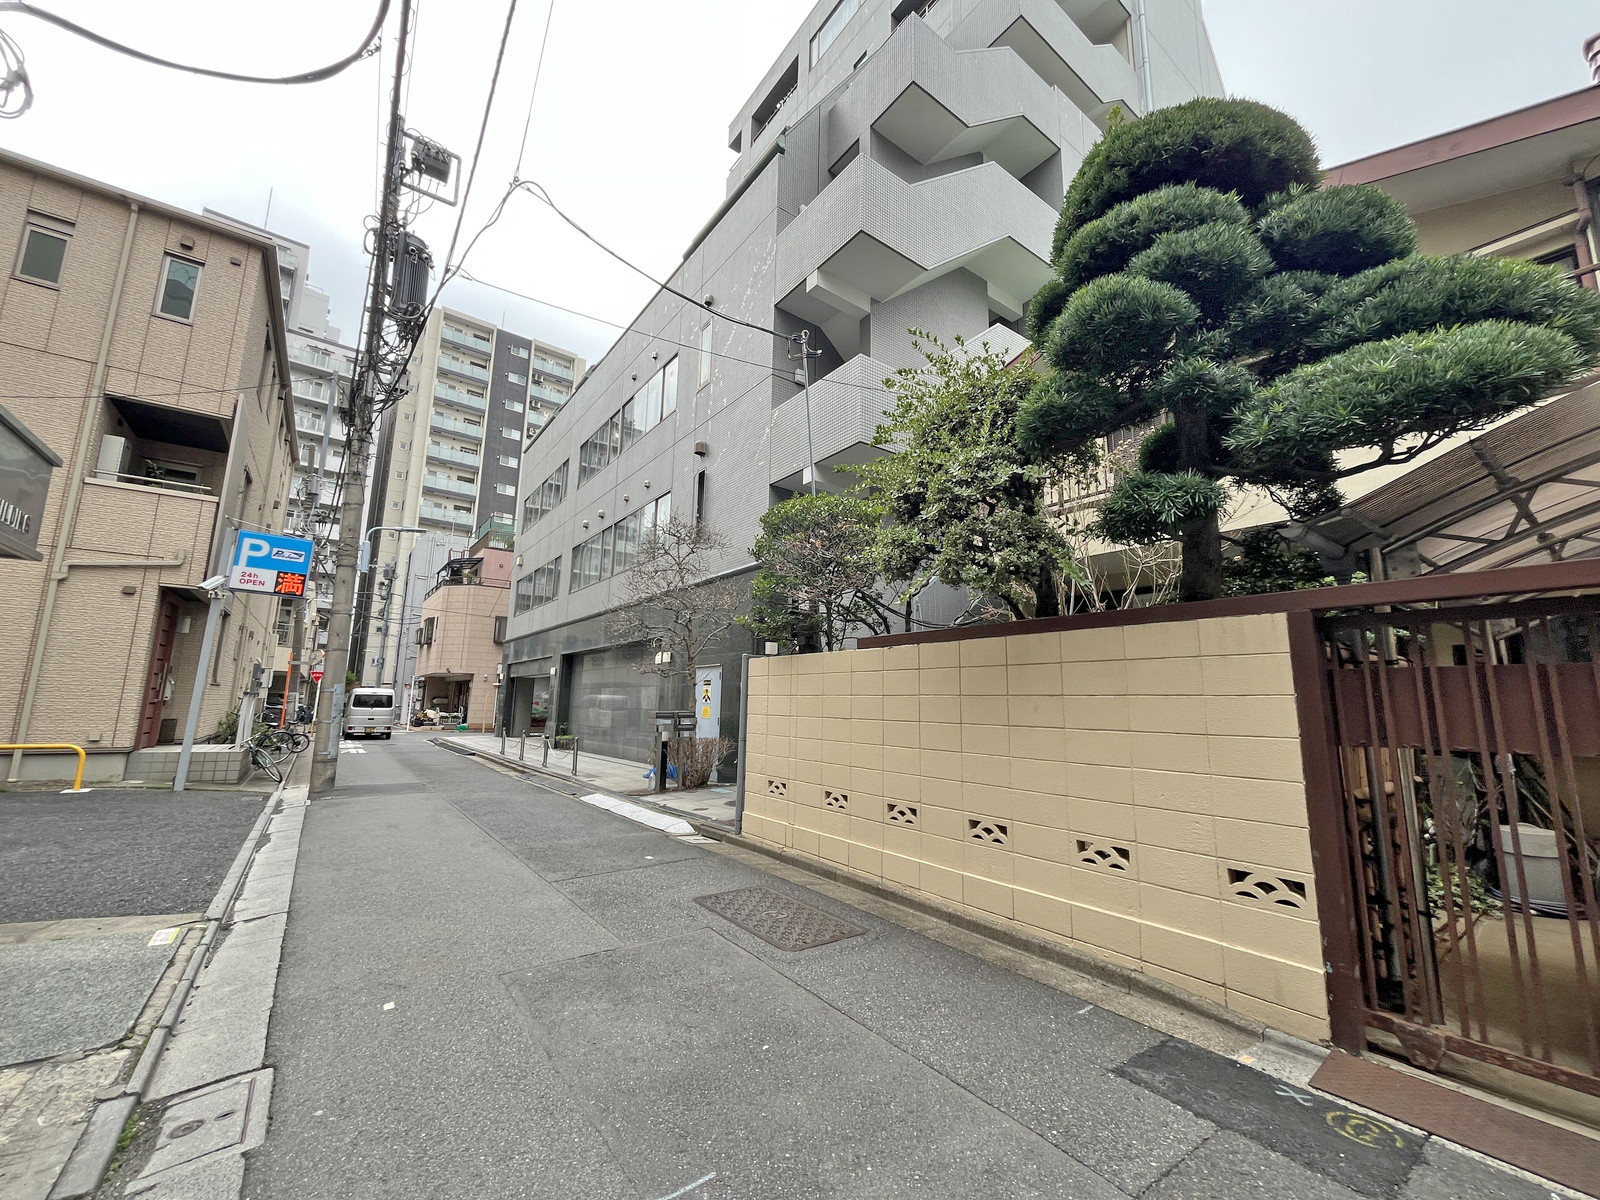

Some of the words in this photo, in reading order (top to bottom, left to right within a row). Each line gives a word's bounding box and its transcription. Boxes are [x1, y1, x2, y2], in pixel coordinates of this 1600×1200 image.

[0, 497, 31, 534] ILDING
[238, 537, 270, 567] P
[239, 578, 266, 586] OPEN
[241, 571, 259, 579] 24h
[275, 572, 305, 596] 満
